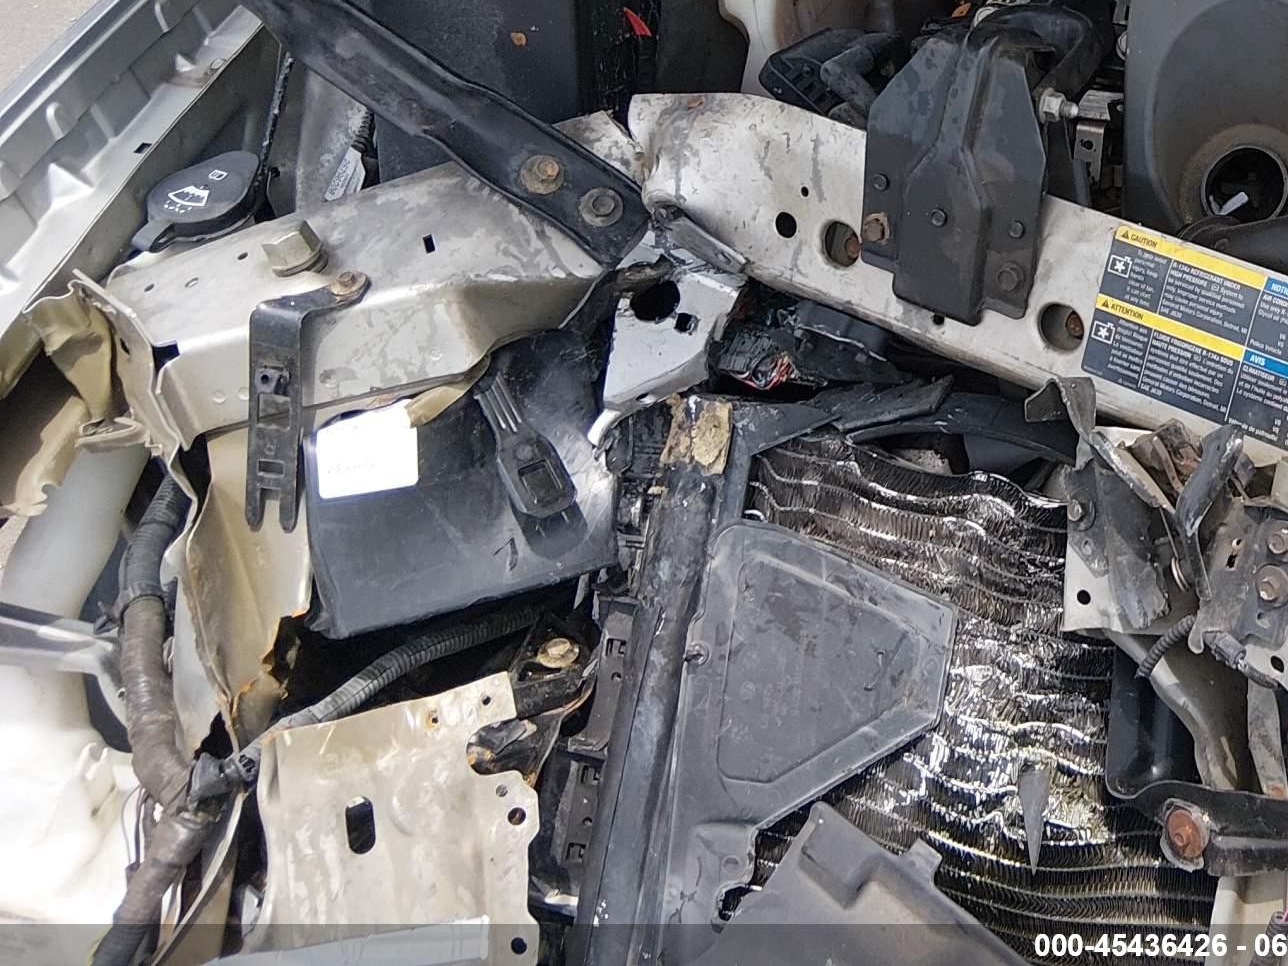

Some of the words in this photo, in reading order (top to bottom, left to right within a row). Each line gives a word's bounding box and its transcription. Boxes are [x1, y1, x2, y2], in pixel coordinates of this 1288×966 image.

[1131, 234, 1157, 248] CAUTION
[1170, 269, 1182, 278] HIGH
[1263, 294, 1272, 302] AIR
[1111, 304, 1143, 320] ATTENTION
[1250, 355, 1265, 366] AVIS
